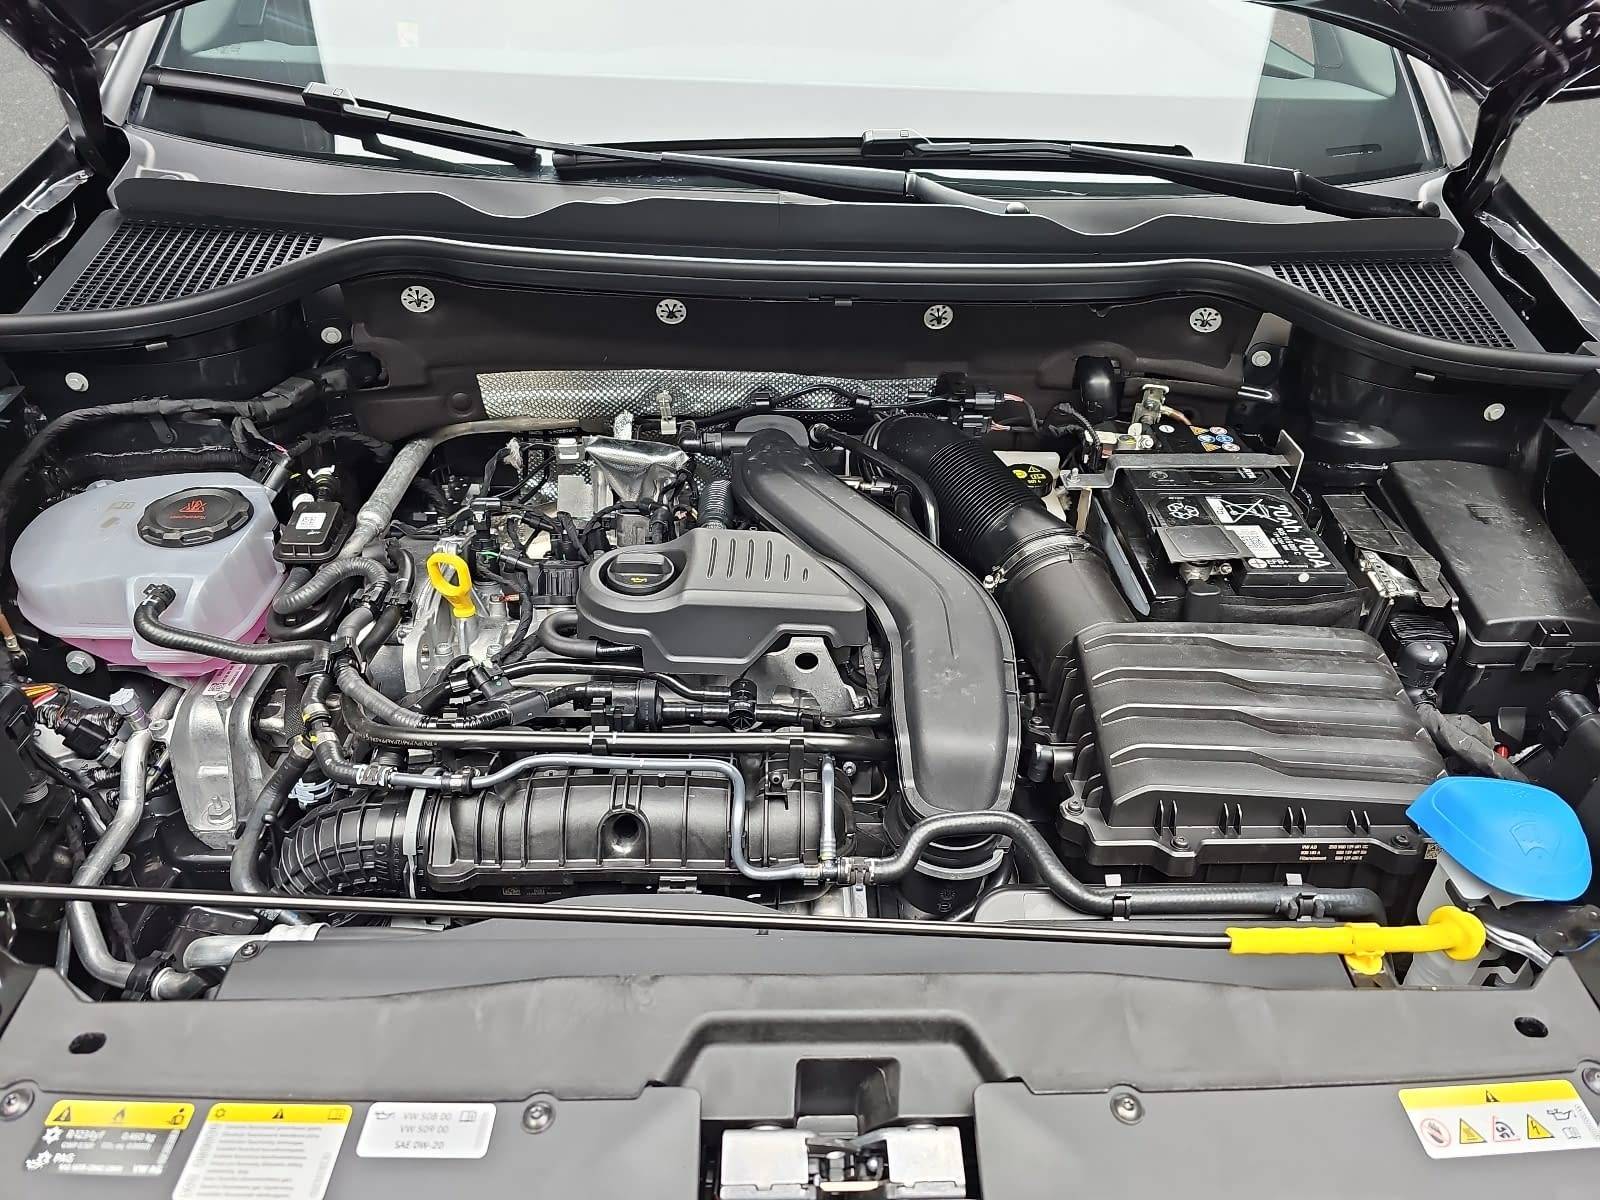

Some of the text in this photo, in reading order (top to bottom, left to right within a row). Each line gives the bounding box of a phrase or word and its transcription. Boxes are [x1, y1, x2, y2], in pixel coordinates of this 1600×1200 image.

[1268, 504, 1303, 533] 70Ah
[1293, 538, 1332, 569] 700A
[403, 1112, 417, 1121] VW
[400, 1125, 415, 1134] VW
[394, 1140, 410, 1149] SAE
